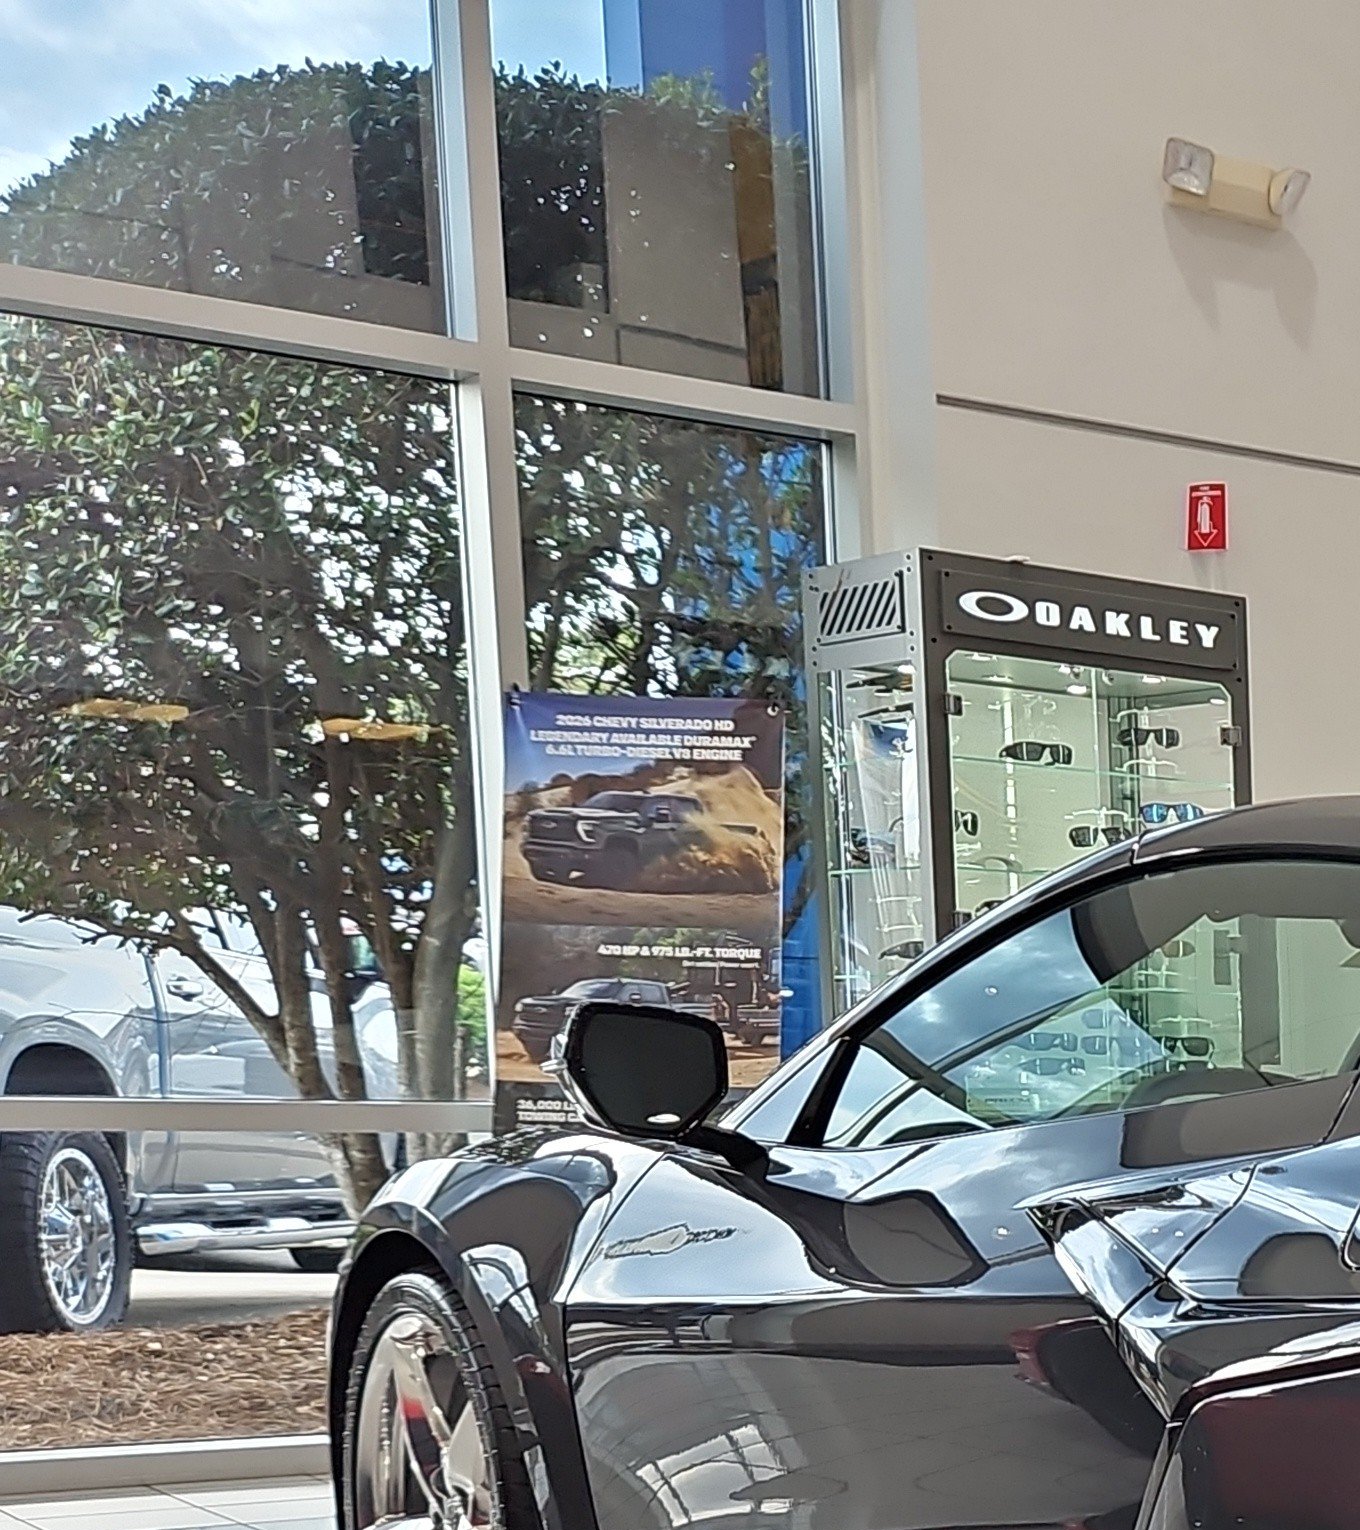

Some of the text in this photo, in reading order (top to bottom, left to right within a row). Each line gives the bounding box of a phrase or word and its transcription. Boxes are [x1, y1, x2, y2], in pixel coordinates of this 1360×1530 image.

[1034, 601, 1221, 650] OAKLEY
[556, 714, 735, 732] 2026 CHEVY SILVERADO HD
[530, 730, 608, 744] LEGENDARY
[610, 733, 682, 746] AVAILABLE
[673, 749, 691, 759] V8
[693, 749, 743, 760] ENGINE
[597, 944, 622, 956] 470
[622, 945, 640, 956] HP
[651, 945, 673, 957] 975
[713, 947, 762, 960] TORQUE
